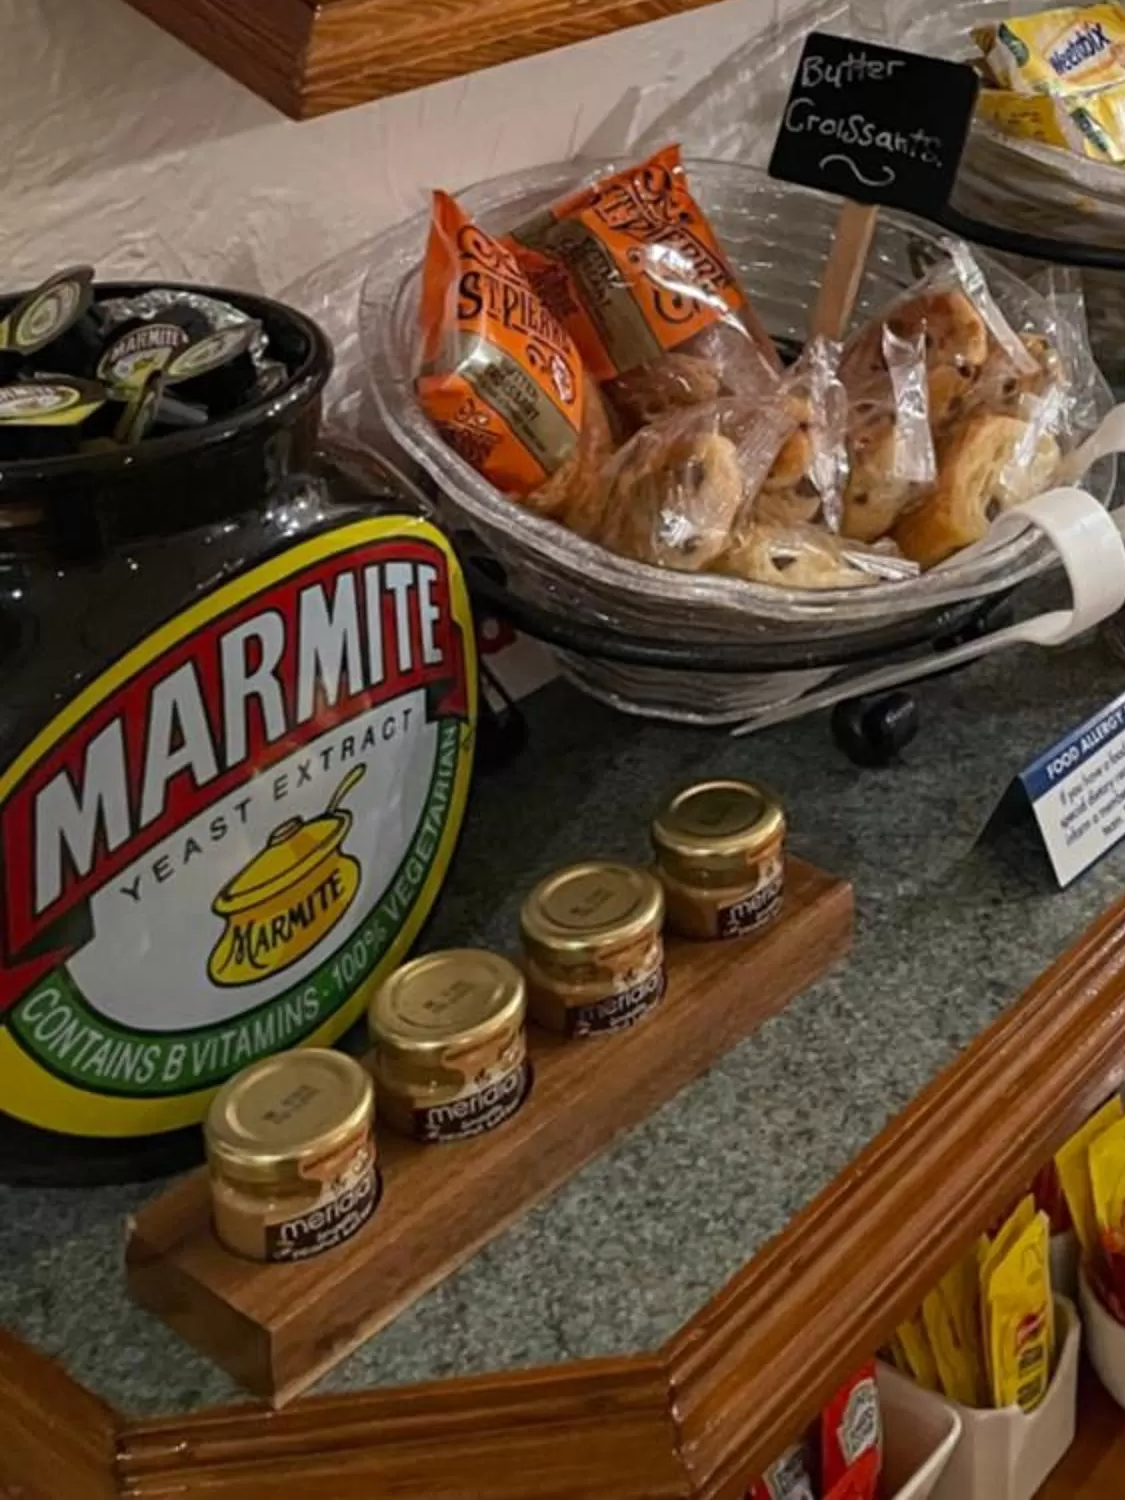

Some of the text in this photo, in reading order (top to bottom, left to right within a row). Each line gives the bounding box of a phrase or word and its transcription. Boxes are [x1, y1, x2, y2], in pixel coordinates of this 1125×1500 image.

[801, 51, 907, 89] Butter
[33, 561, 445, 916] MARMITE
[119, 707, 414, 902] YEAST EXTRACT
[1047, 747, 1080, 780] FOOD
[1080, 710, 1125, 753] ALLERGY
[20, 725, 460, 1084] CONTAINS B VITAMINS 100% VEGETARIAN
[217, 866, 347, 974] MARMITE
